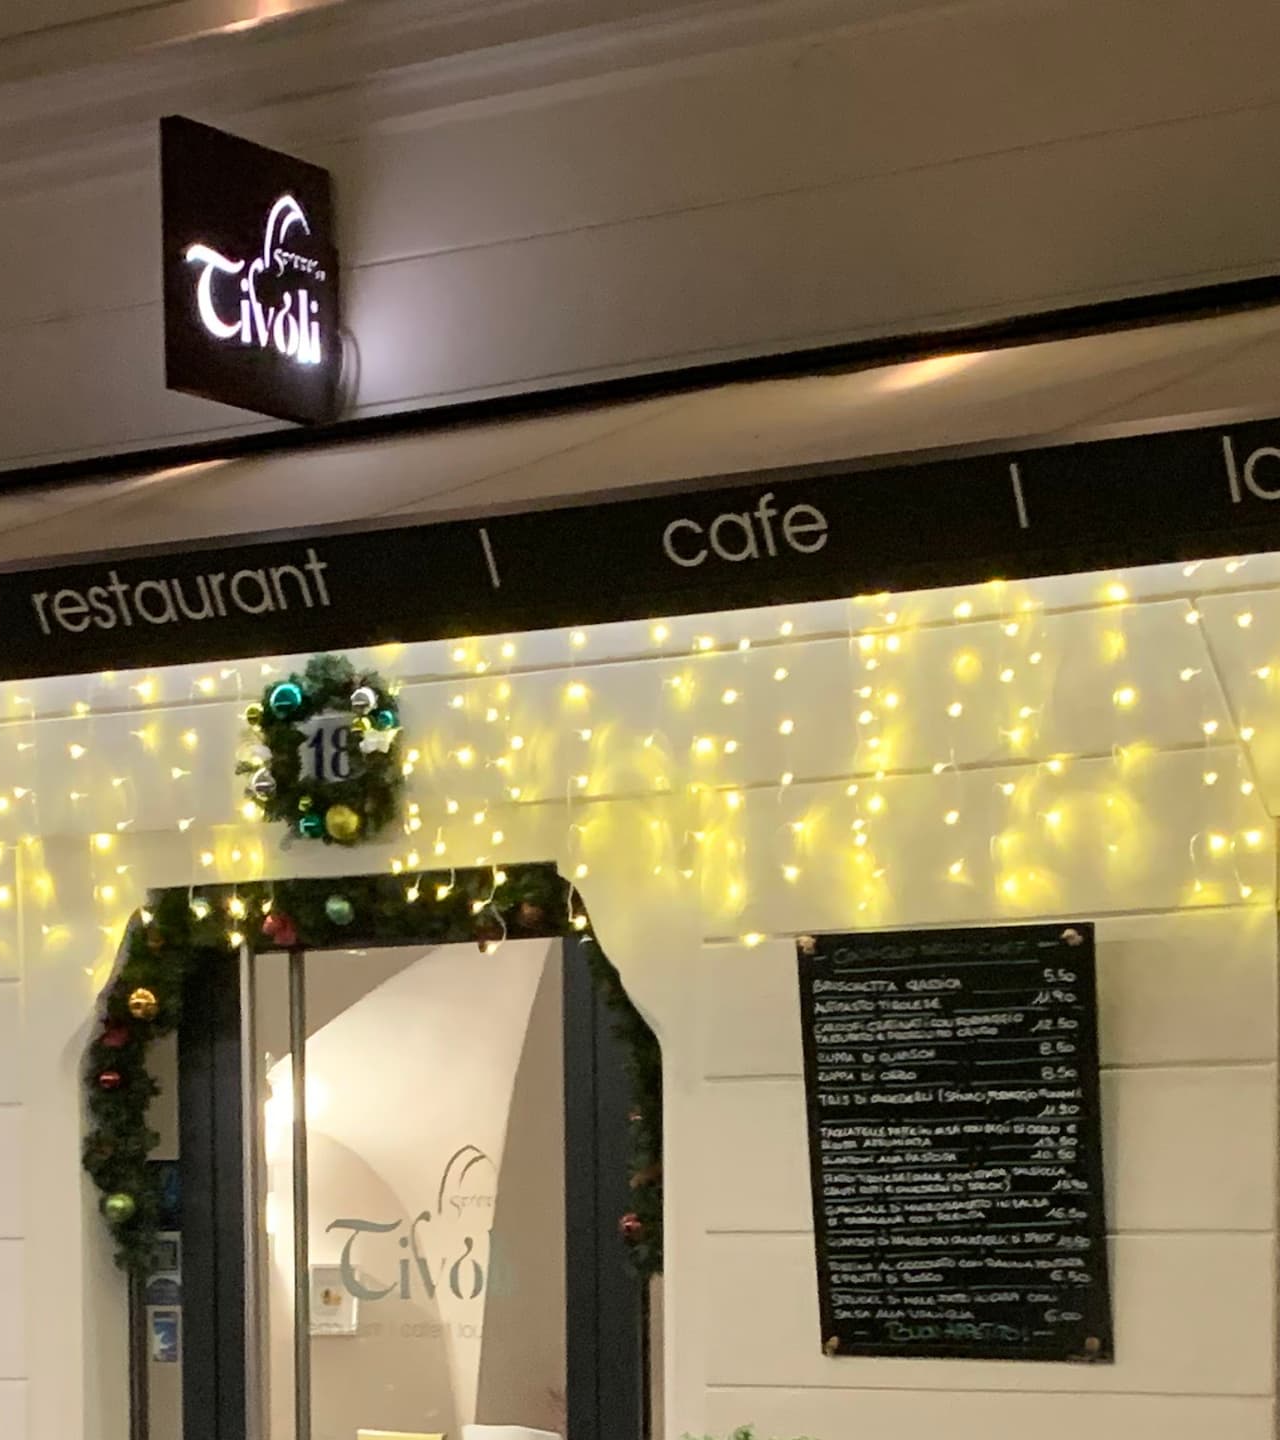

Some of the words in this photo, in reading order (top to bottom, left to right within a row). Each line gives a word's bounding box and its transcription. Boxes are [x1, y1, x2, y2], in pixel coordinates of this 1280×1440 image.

[185, 242, 322, 364] Tivoli
[32, 547, 331, 635] restaurant
[663, 493, 828, 568] cafe
[309, 726, 352, 780] 18
[324, 1210, 514, 1301] Tivo
